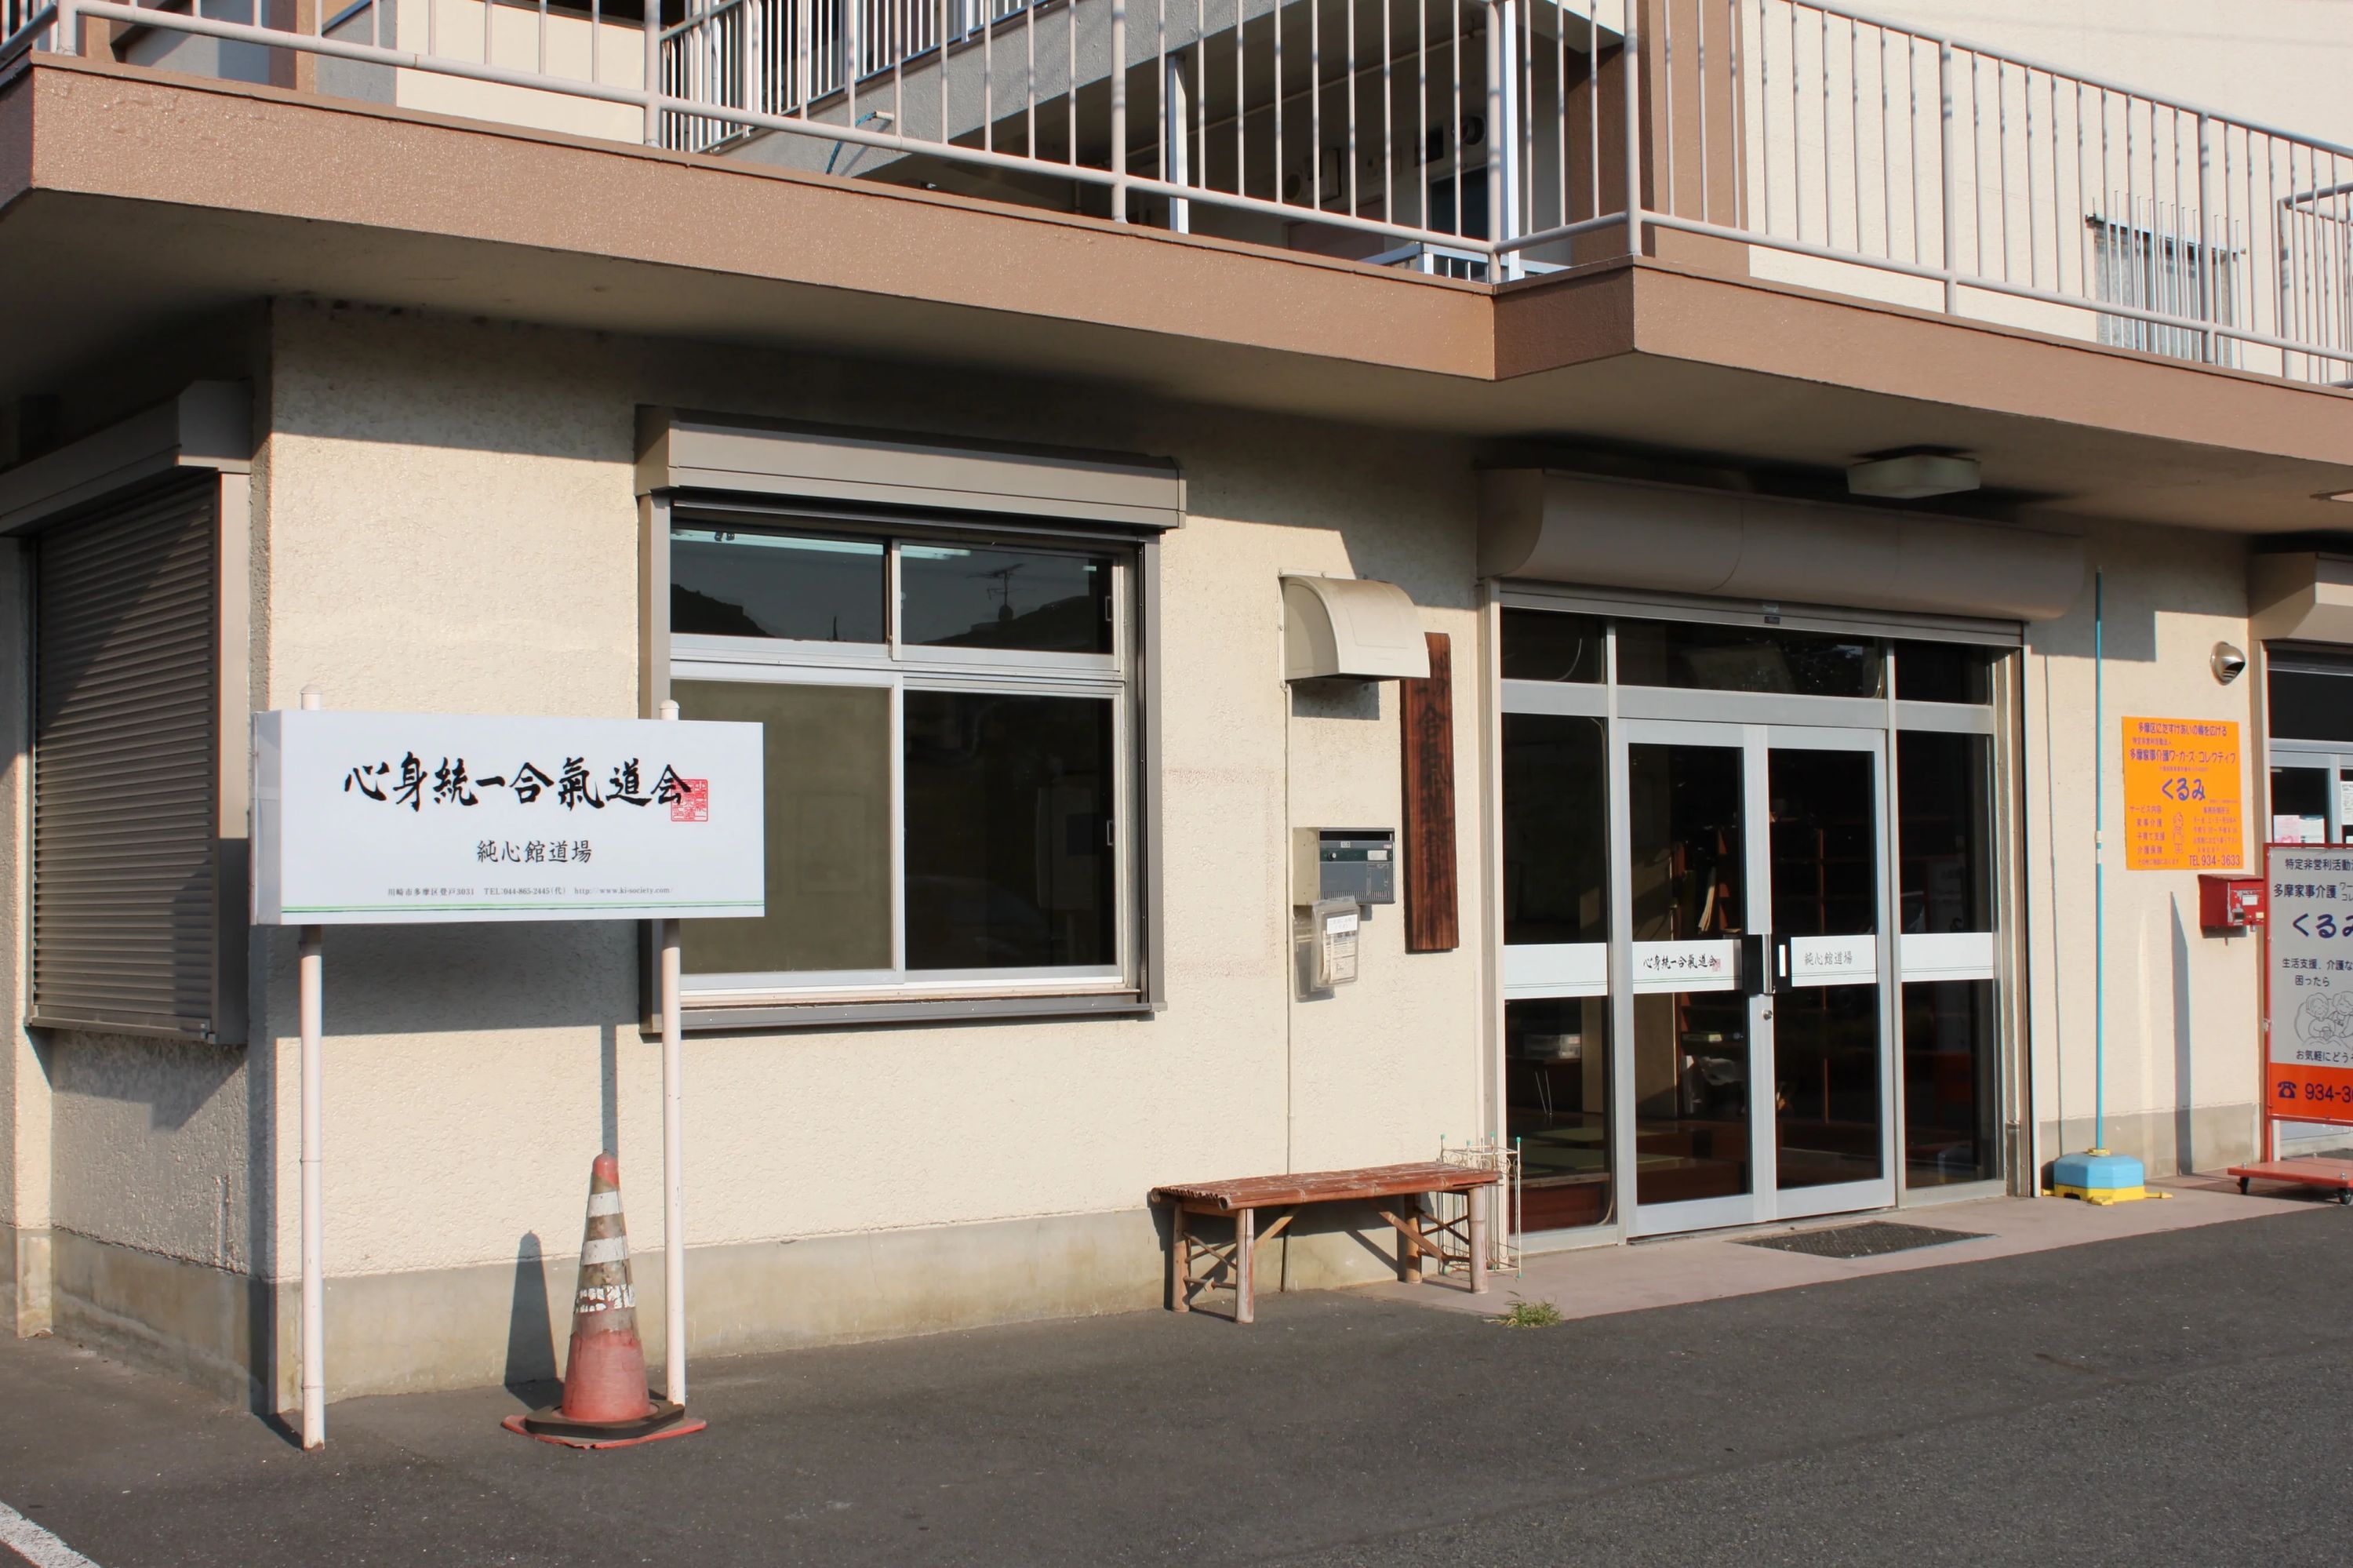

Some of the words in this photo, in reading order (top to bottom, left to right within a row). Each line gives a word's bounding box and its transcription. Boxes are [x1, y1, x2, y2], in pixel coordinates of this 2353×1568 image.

[343, 751, 692, 812] 心身統一合氣道会
[2162, 777, 2206, 801] くるみ
[475, 839, 593, 864] 純心館道場
[2189, 854, 2200, 866] TEL
[2274, 883, 2337, 899] 多摩家事介護
[1804, 950, 1853, 966] 純心館道場
[2295, 974, 2329, 987] 困ったら
[2296, 1050, 2353, 1064] お気軽にどう
[2304, 1082, 2353, 1104] 934-3
